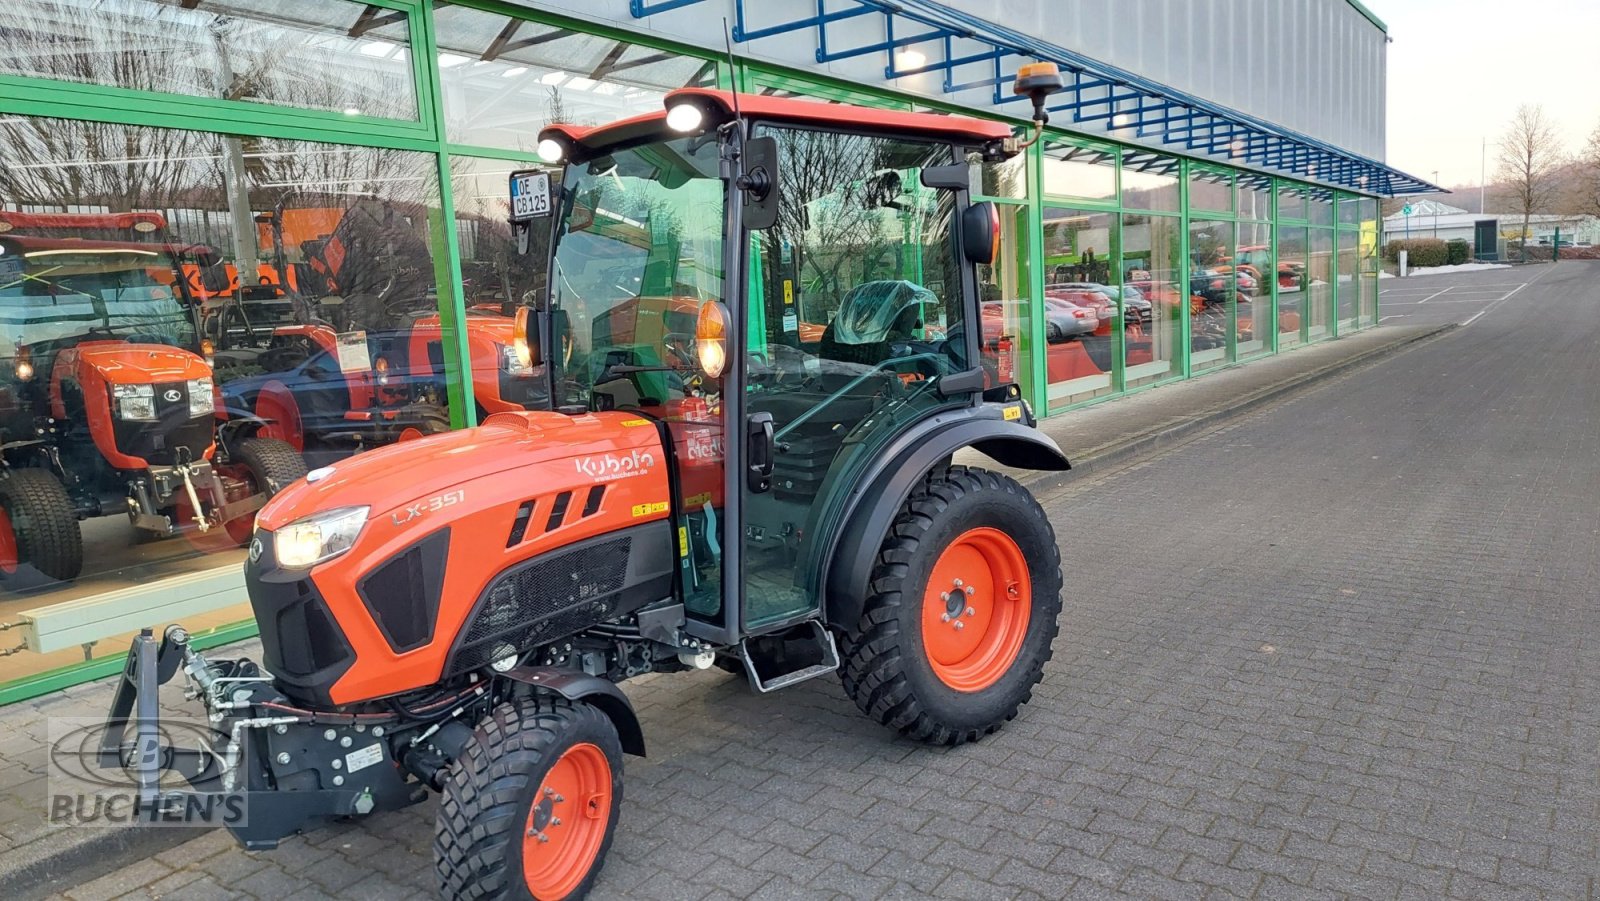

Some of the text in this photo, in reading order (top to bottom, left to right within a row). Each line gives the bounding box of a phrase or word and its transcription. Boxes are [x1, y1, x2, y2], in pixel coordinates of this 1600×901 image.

[519, 179, 531, 196] OE
[516, 194, 547, 214] CB 125
[575, 450, 654, 476] Kubota
[594, 468, 648, 482] www.buchens.de
[391, 489, 465, 526] LX-351
